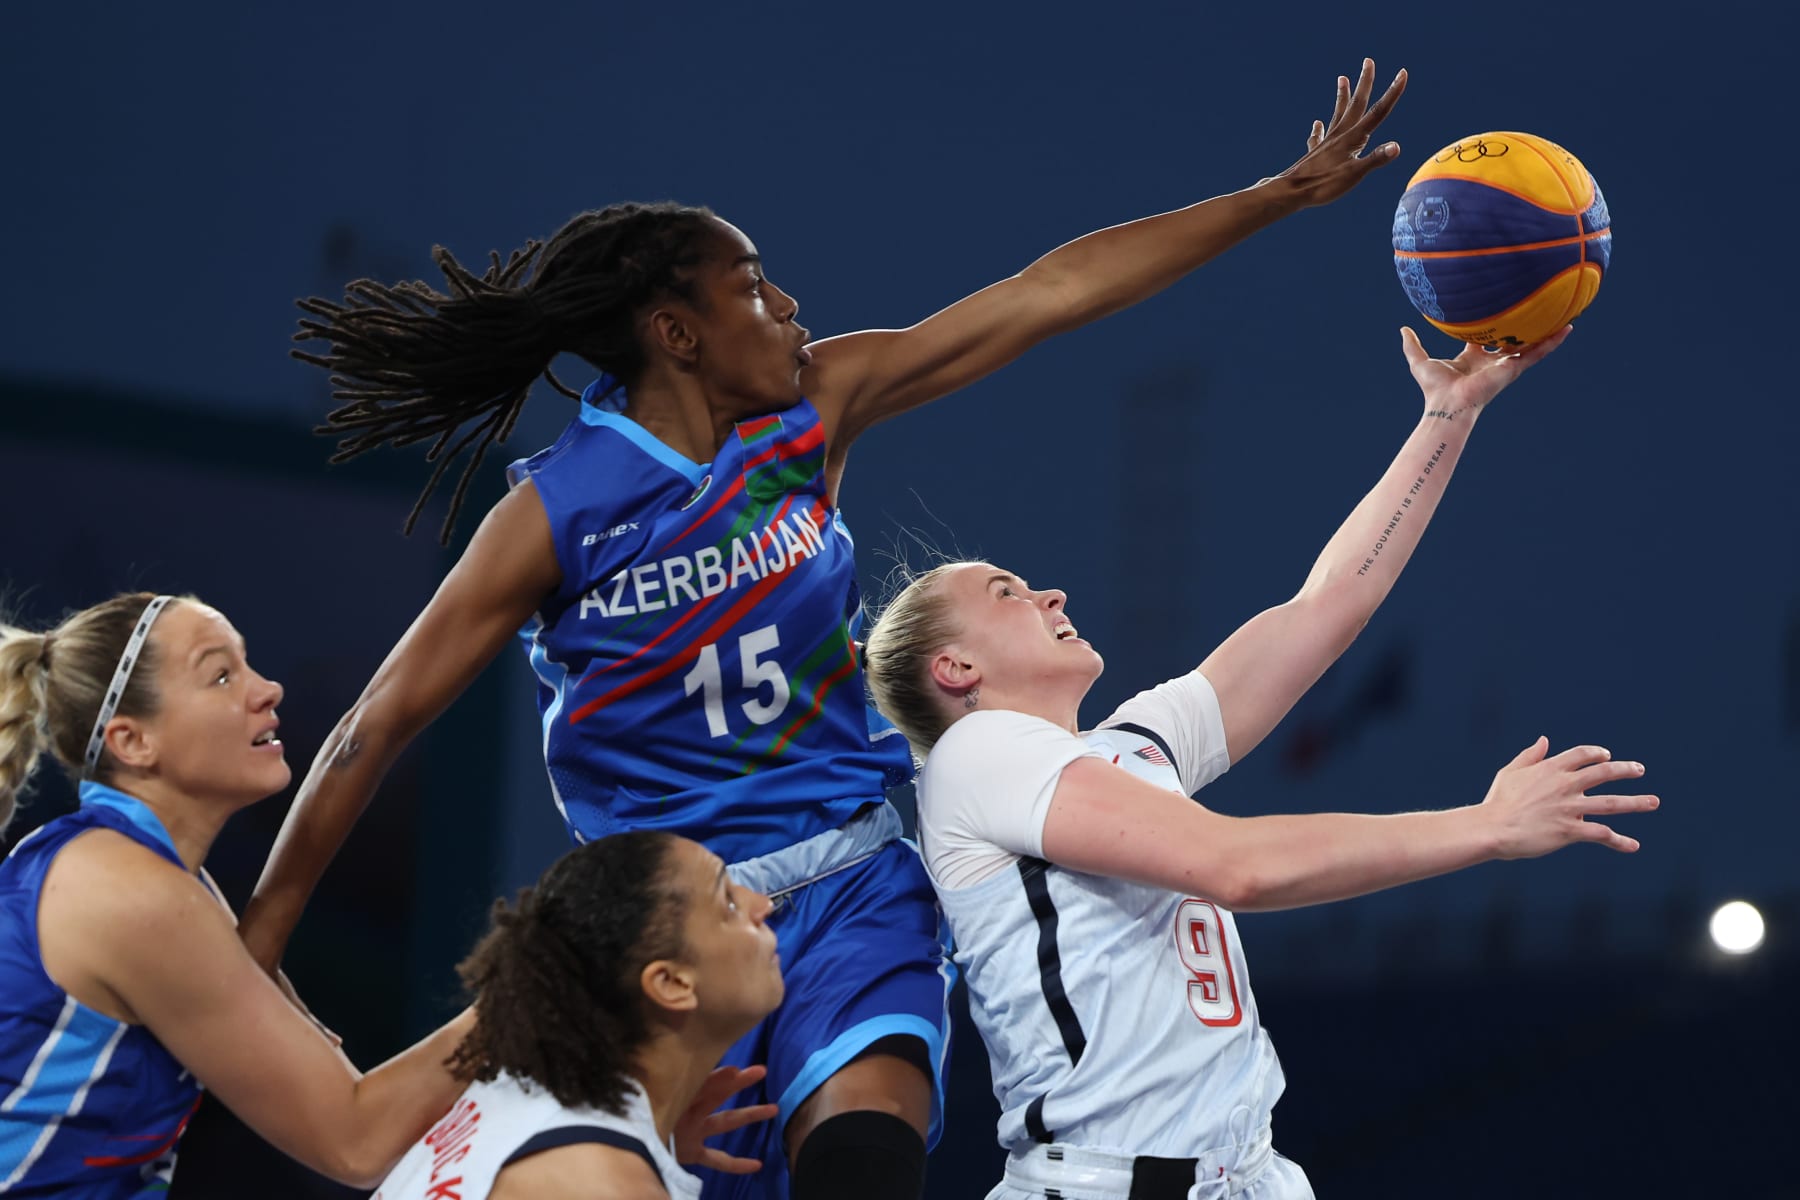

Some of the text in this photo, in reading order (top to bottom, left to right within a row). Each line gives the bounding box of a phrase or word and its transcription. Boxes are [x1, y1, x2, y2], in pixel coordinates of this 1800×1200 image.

[579, 507, 826, 620] AZERBAIJAN
[1357, 442, 1448, 577] THE JOURNEY IS THE DREAM
[684, 624, 791, 738] 15
[1174, 898, 1243, 1027] 9
